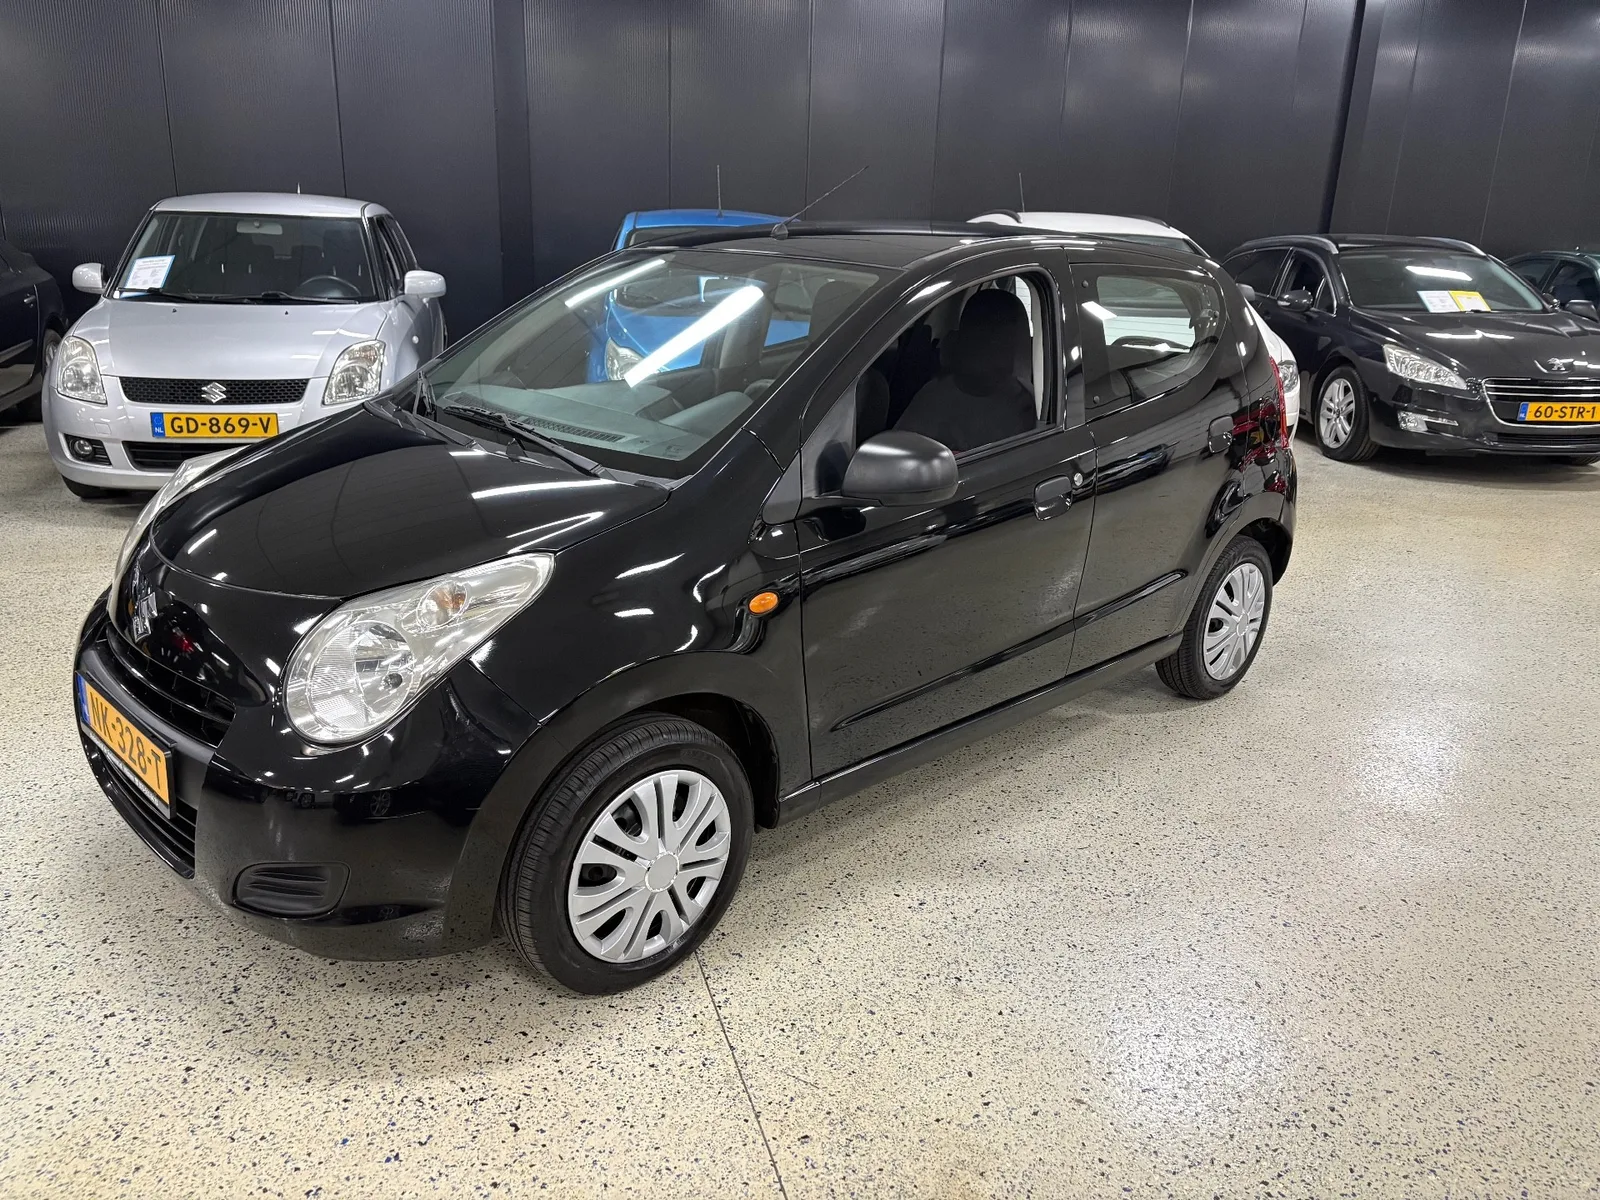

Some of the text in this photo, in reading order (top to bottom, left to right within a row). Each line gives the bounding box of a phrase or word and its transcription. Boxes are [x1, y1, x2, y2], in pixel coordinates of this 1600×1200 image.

[1534, 405, 1596, 419] 60-STR-1
[170, 416, 271, 434] GD-869-V
[89, 691, 161, 790] NK-328-T
